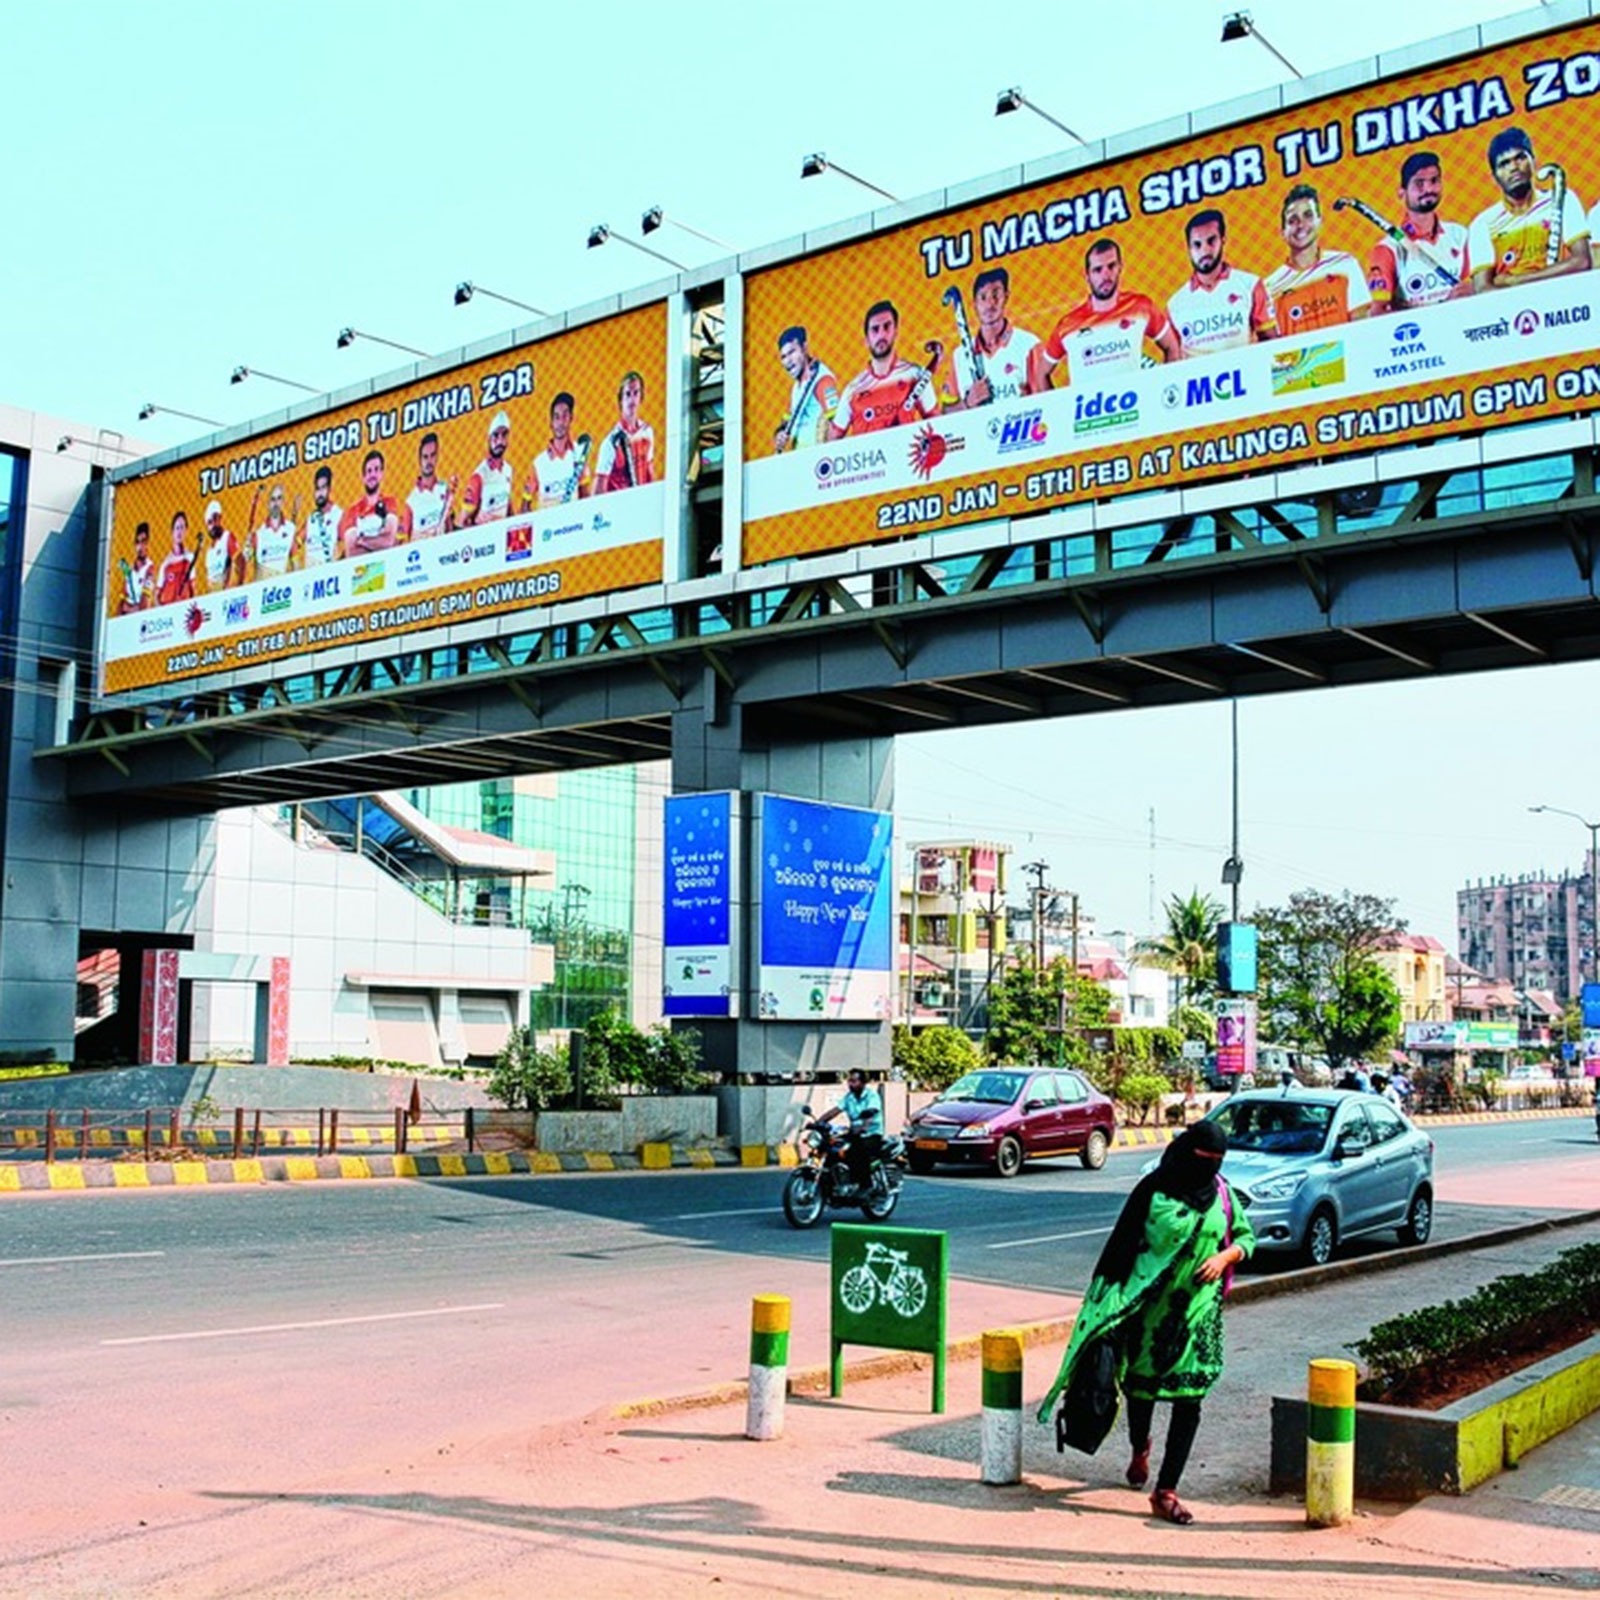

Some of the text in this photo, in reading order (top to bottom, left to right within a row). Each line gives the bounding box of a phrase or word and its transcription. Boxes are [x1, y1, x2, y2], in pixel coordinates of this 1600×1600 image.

[921, 230, 972, 277] TU
[981, 186, 1131, 260] MACHA
[1140, 146, 1266, 214] SHOR
[1276, 121, 1342, 177] TU
[1353, 76, 1514, 155] DIKHA
[1543, 304, 1591, 329] NALCO
[1389, 341, 1427, 358] TATA
[1373, 355, 1446, 379] TATA STEEL
[1185, 368, 1247, 407] MCL
[1074, 390, 1139, 421] idco
[199, 362, 534, 497] TU MACHA SHOR TU DIKHA ZOR
[877, 492, 943, 530] 22ND
[948, 481, 998, 517] JAN
[1081, 456, 1132, 490] FEB
[1139, 445, 1173, 478] AT
[1181, 422, 1311, 472] KALINGA
[1316, 389, 1464, 444] STADIUM
[1472, 374, 1548, 416] 6PM
[261, 585, 292, 606] idco
[312, 575, 341, 601] MCL
[166, 649, 200, 673] 22ND
[200, 645, 225, 666] JAN
[261, 631, 285, 653] FEB
[287, 626, 305, 647] AT
[306, 614, 365, 644] KALINGA
[368, 600, 434, 633] STADIUM
[438, 591, 473, 616] 6PM
[475, 571, 562, 610] ONWARDS
